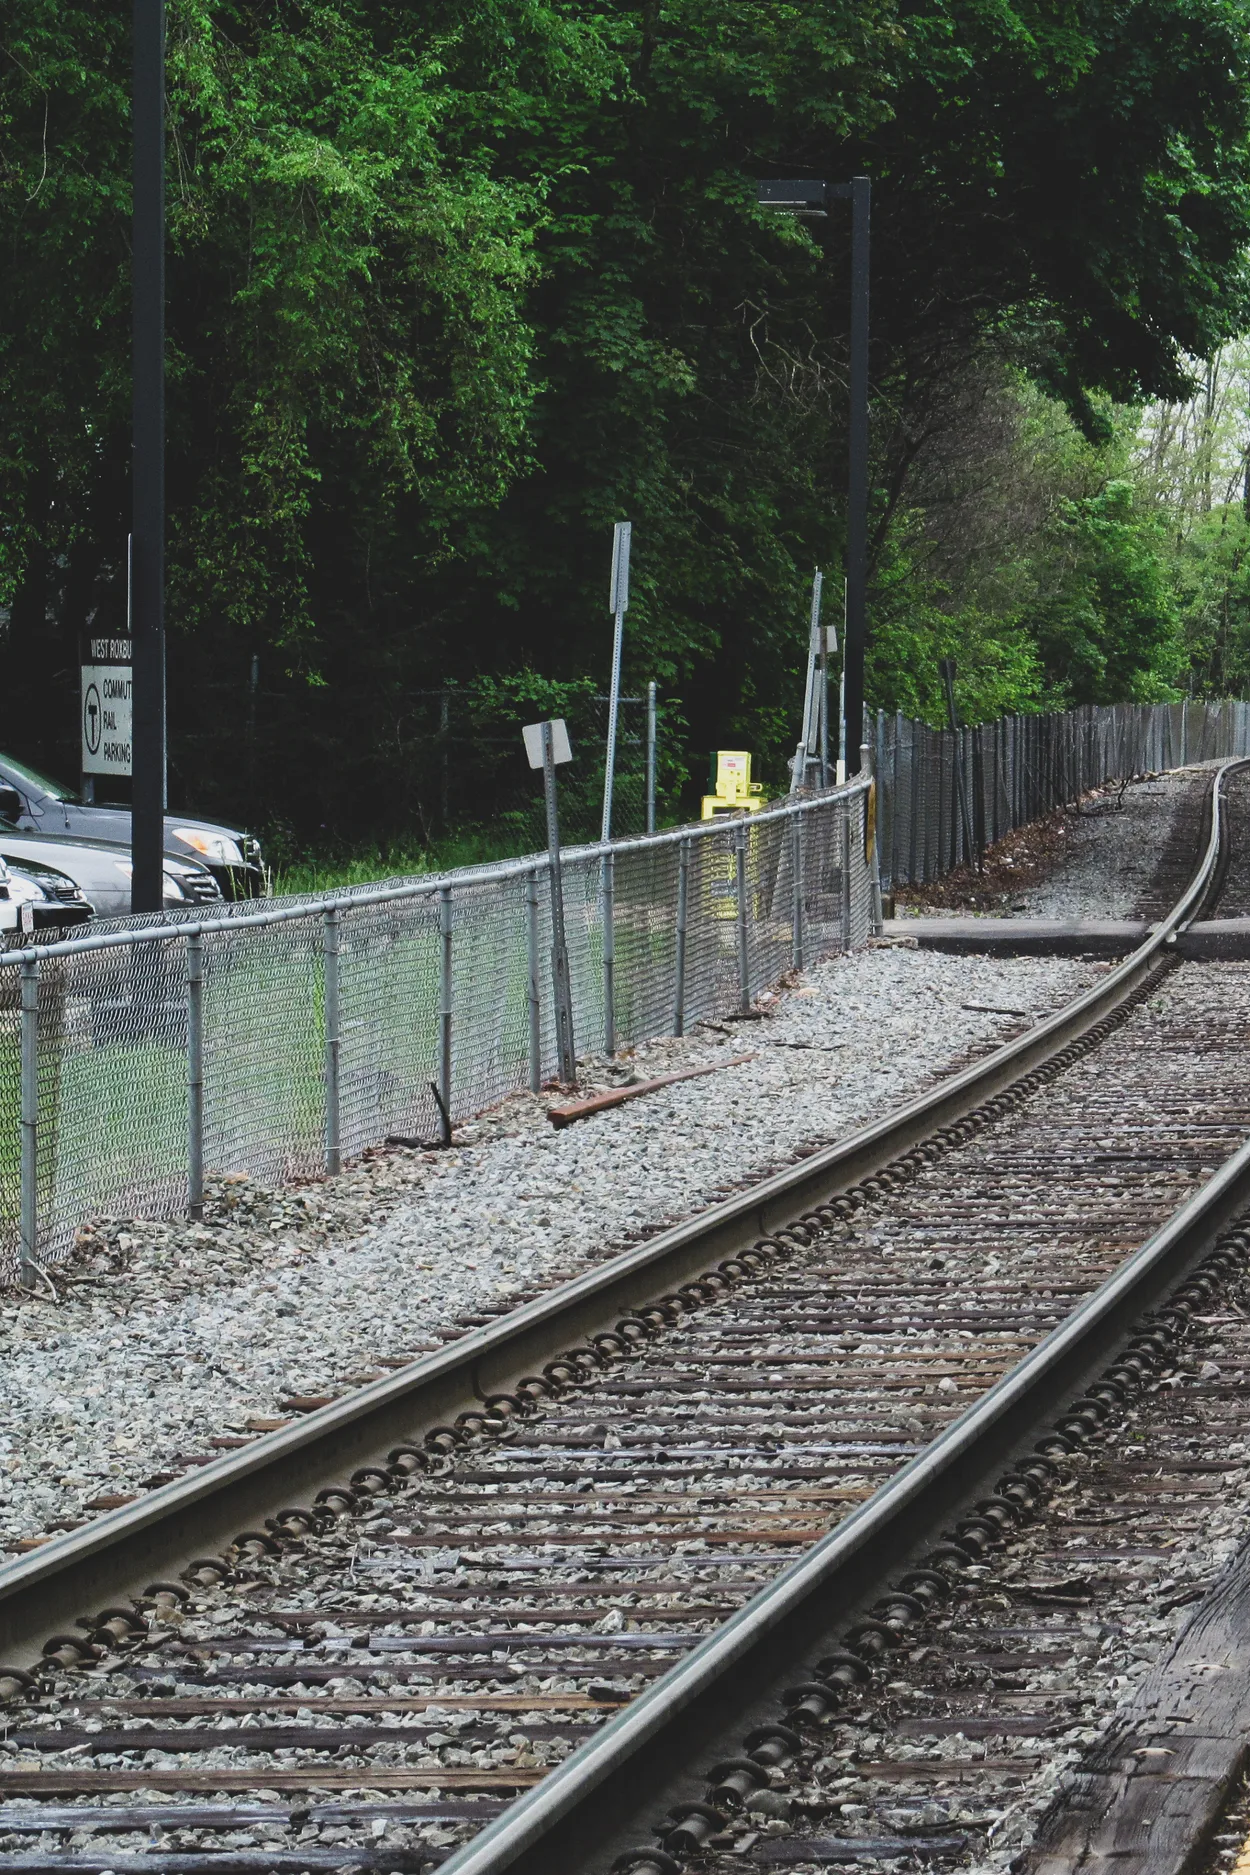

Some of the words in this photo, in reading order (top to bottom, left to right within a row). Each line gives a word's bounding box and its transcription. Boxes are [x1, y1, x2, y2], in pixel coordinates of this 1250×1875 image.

[91, 639, 109, 659] WEST
[109, 639, 132, 660] ROXBU
[103, 679, 132, 700] COMMUT
[103, 711, 117, 730] RAIL
[104, 742, 131, 763] PARKING
